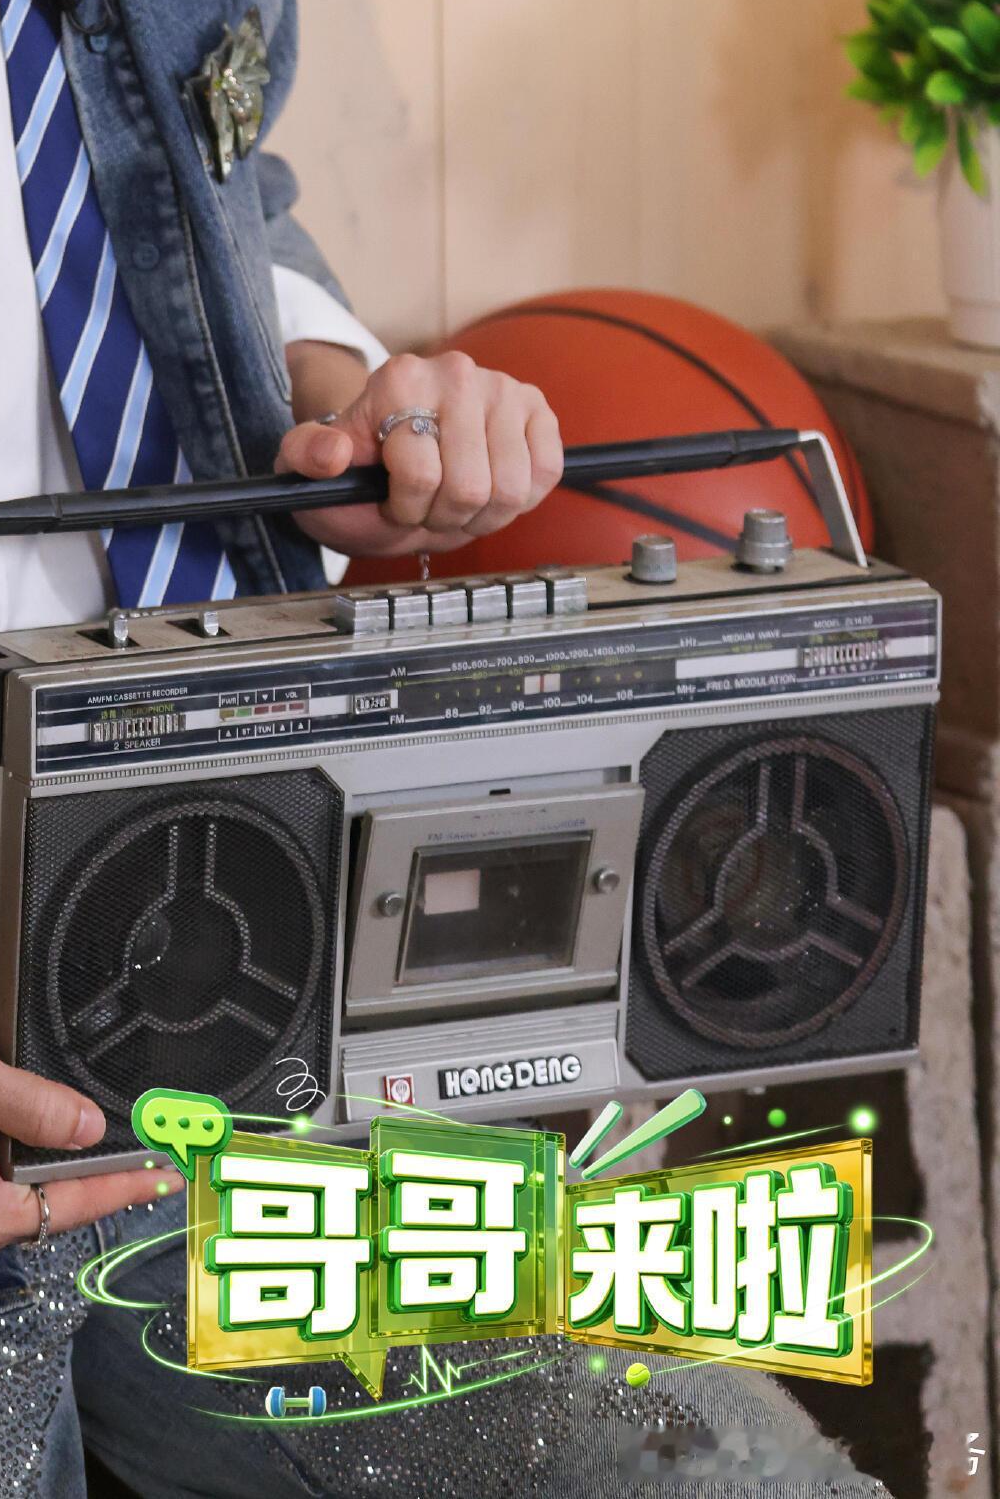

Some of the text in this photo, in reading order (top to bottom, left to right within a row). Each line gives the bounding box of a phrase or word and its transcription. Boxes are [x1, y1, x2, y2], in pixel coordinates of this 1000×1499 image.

[390, 666, 406, 678] AM
[497, 656, 513, 666] 700
[518, 654, 535, 665] 800
[545, 651, 566, 661] 1000
[570, 648, 590, 659] 1200
[593, 646, 614, 656] 1400
[722, 631, 755, 643] MEDIUM
[758, 628, 780, 639] WAVE
[87, 686, 188, 705] AM/FM CASSETTE RECORDER
[222, 691, 298, 706] PWR VOL
[390, 713, 405, 725] FM
[445, 708, 460, 719] 88
[479, 705, 492, 716] 92
[543, 697, 561, 708] 100
[576, 694, 593, 705] 104
[616, 689, 634, 701] 108
[677, 684, 697, 694] MHz
[735, 674, 797, 689] MODULATION
[258, 725, 272, 734] TUN
[113, 737, 161, 751] 2 SPEAKER
